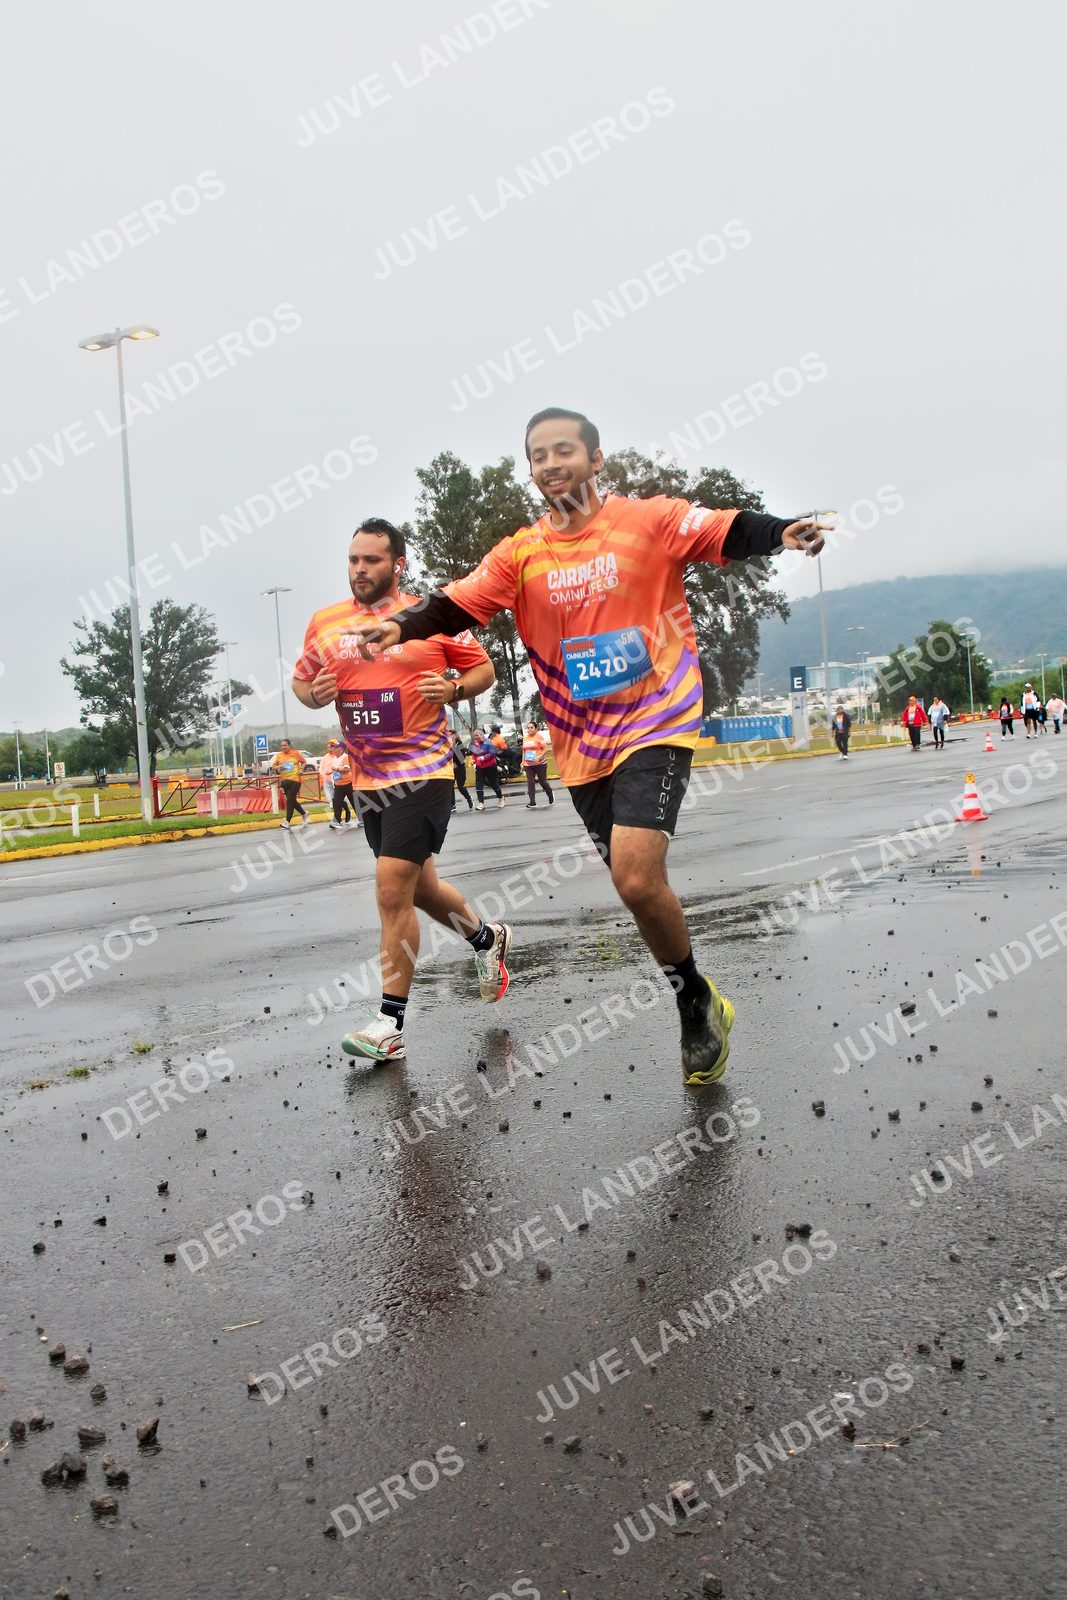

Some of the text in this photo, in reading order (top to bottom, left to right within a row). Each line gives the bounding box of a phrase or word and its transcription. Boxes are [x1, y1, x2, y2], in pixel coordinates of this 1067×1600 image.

[547, 551, 617, 590] CARRERA
[549, 580, 604, 605] OMNILIFE
[576, 656, 628, 681] 2470
[793, 677, 803, 689] E
[353, 710, 381, 725] 515
